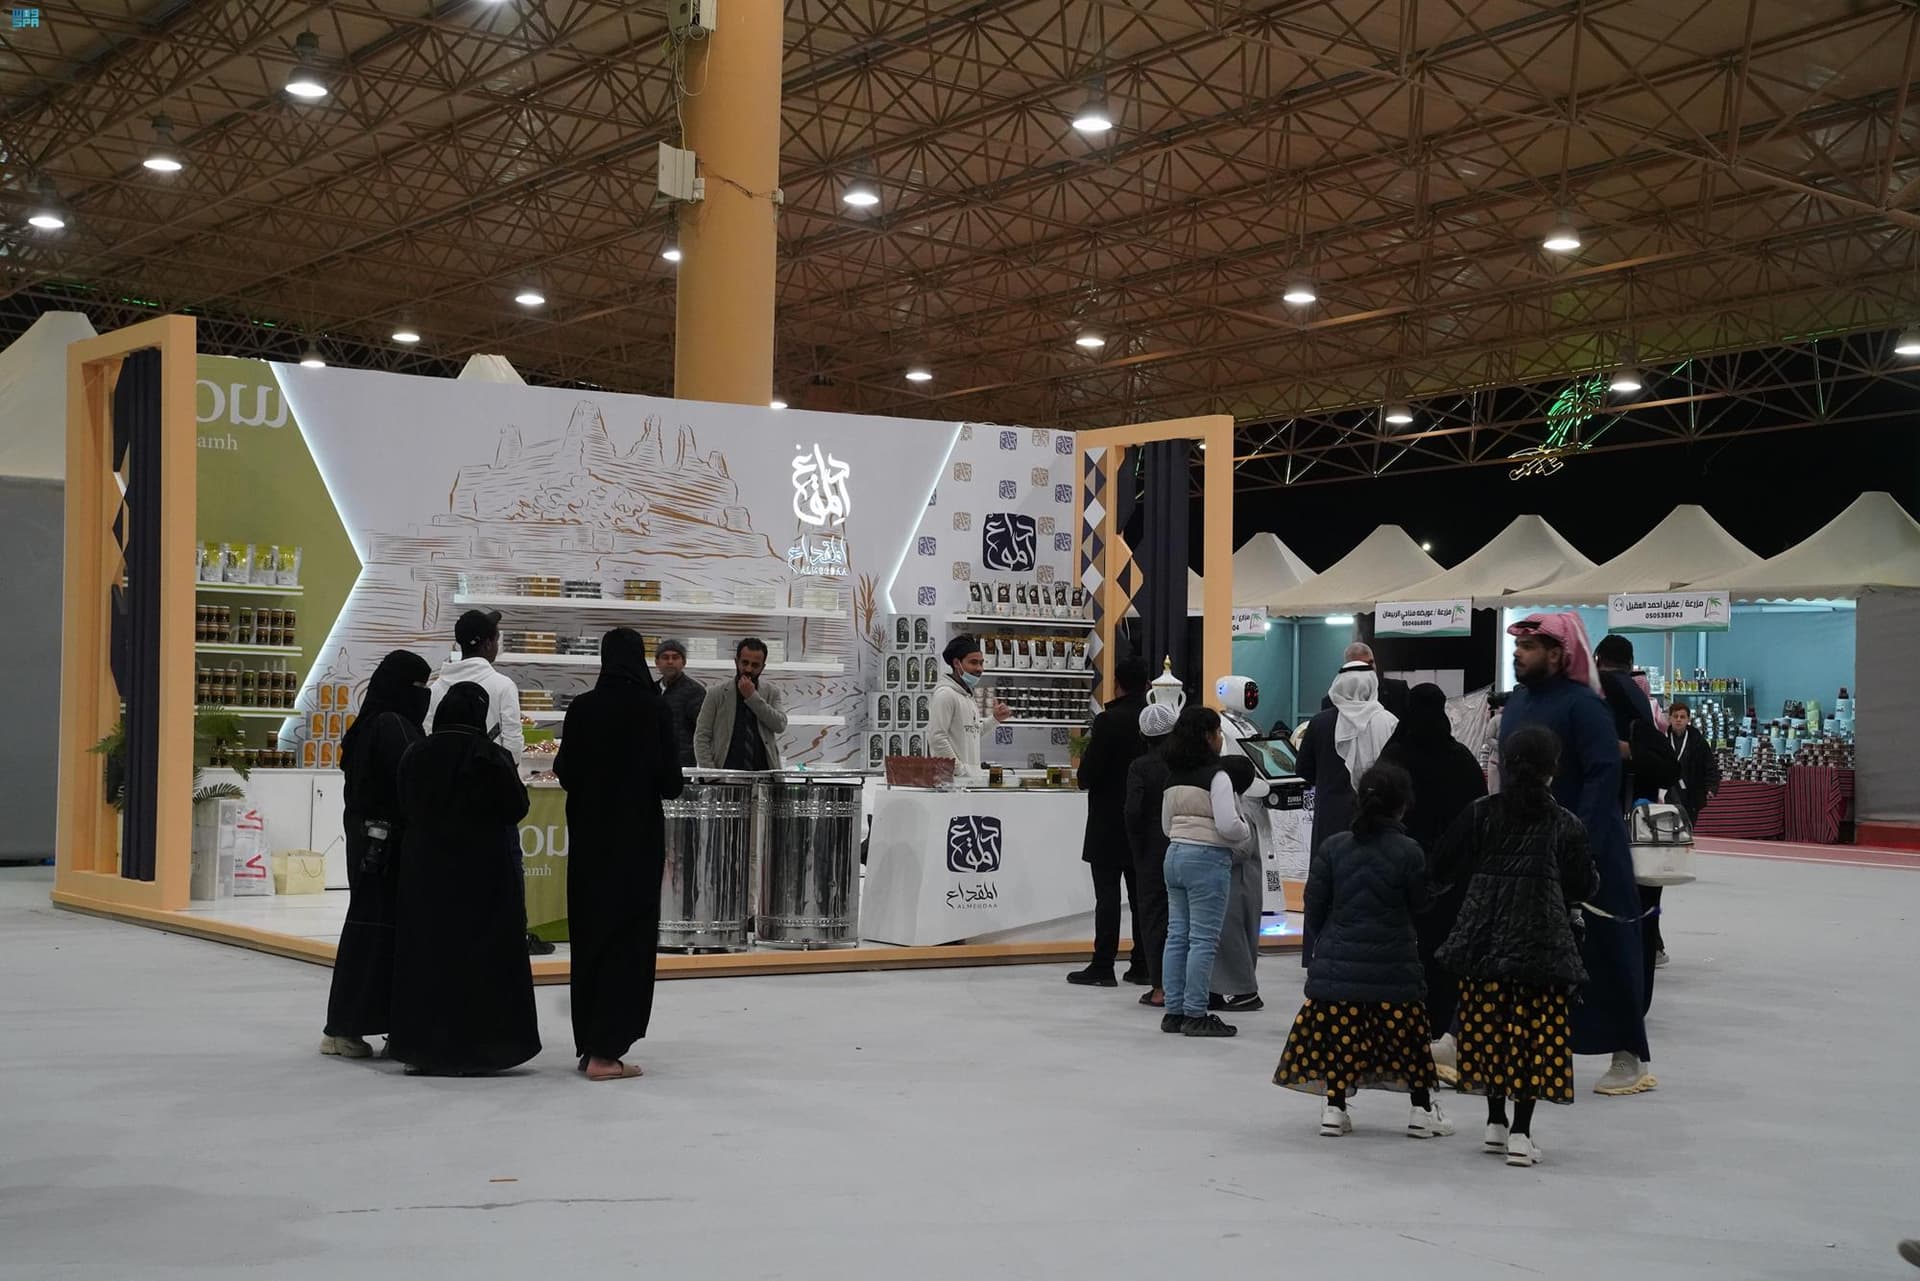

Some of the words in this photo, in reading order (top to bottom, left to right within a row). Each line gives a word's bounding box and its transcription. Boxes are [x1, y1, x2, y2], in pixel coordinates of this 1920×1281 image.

[197, 433, 238, 450] amh
[1684, 599, 1704, 608] مزرعة
[945, 881, 998, 909] المقداع
